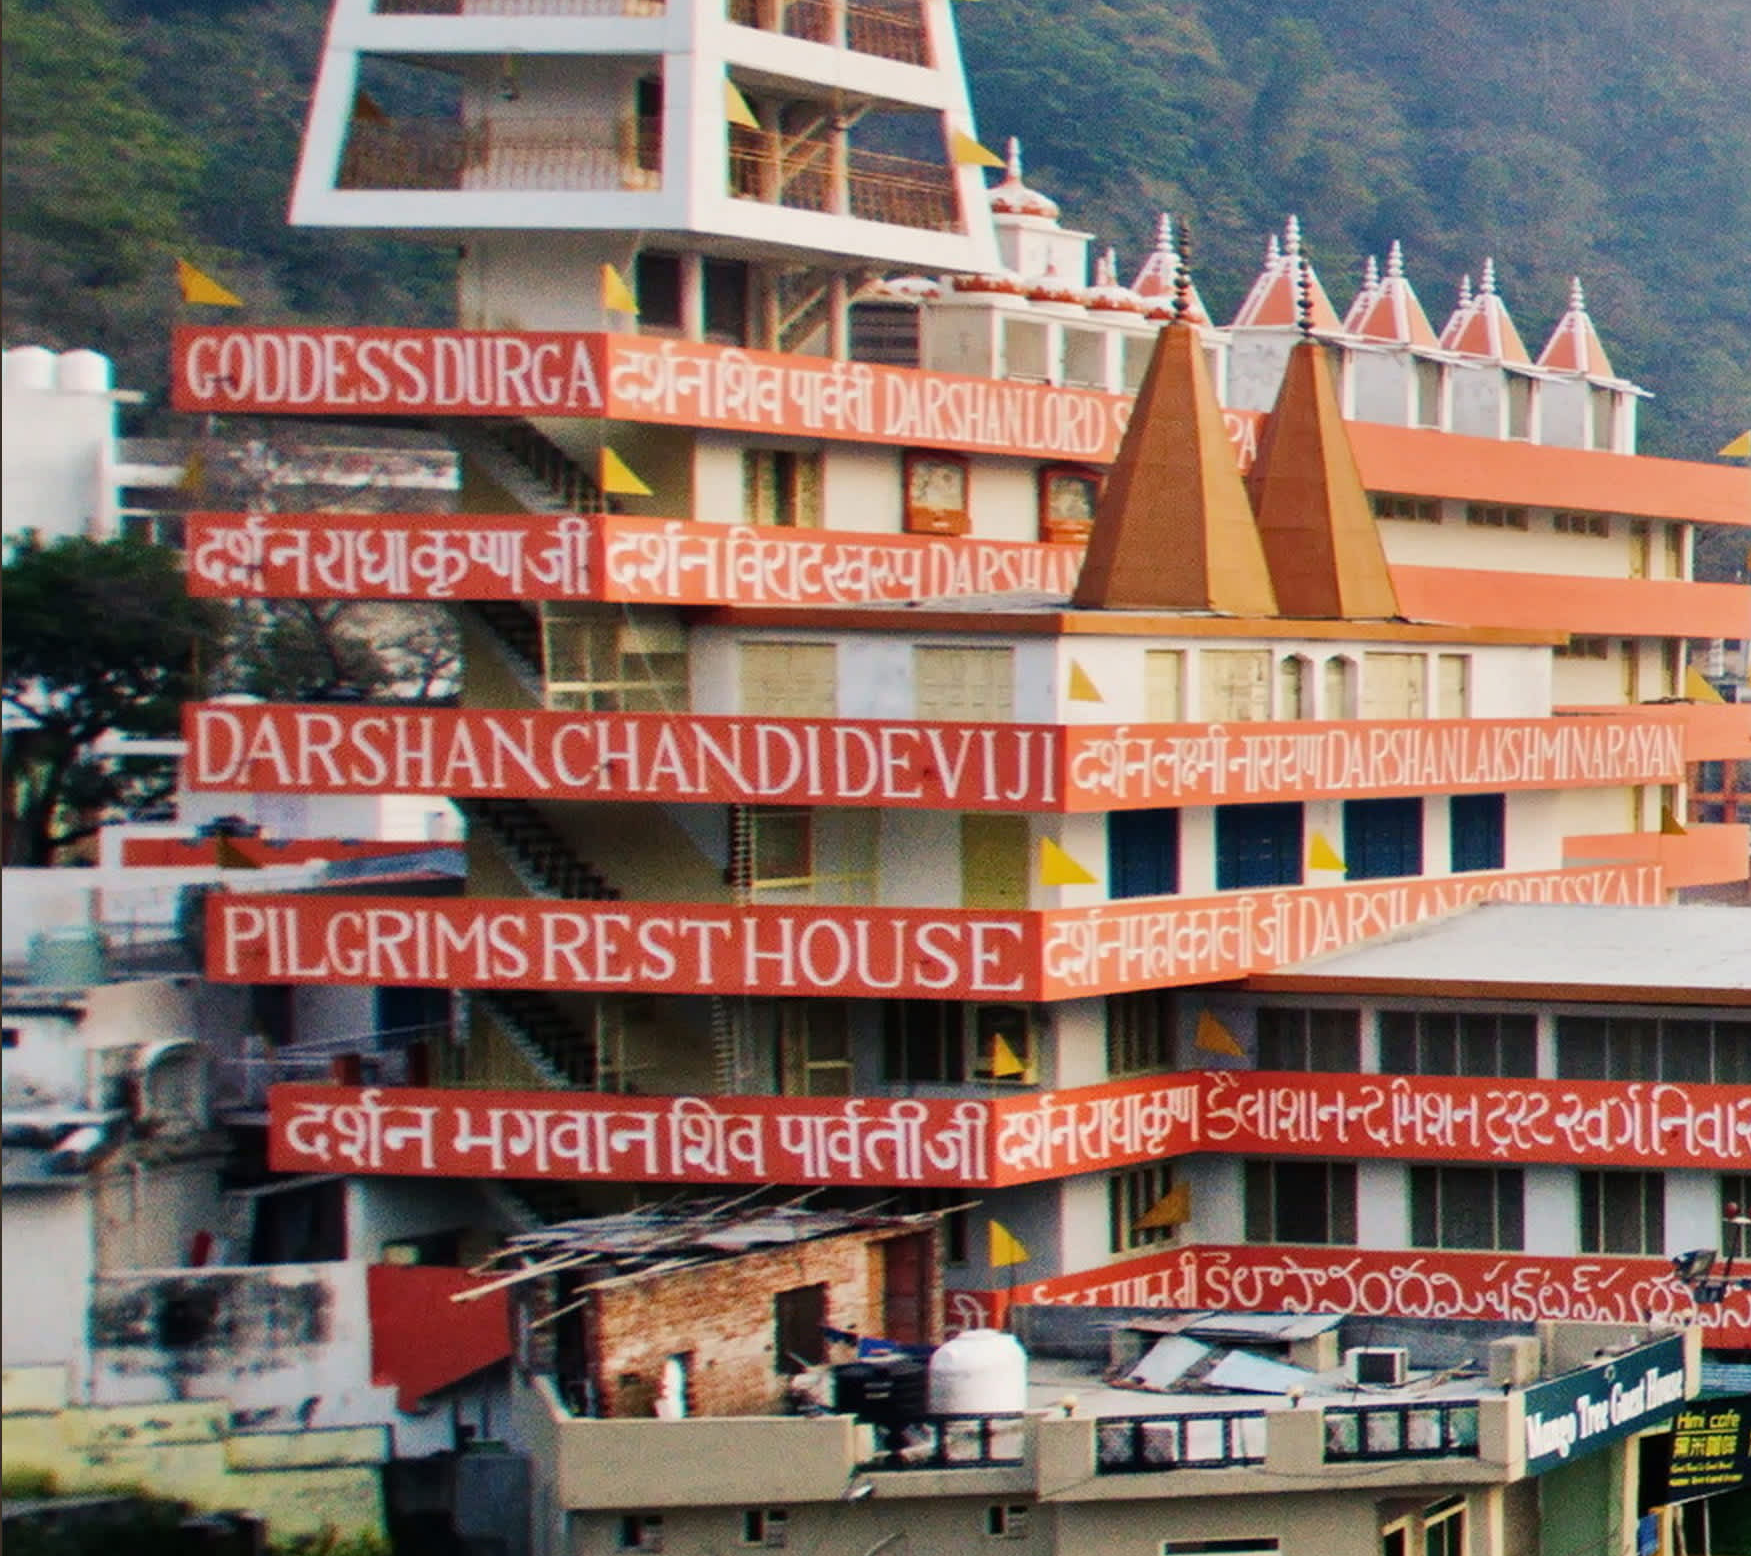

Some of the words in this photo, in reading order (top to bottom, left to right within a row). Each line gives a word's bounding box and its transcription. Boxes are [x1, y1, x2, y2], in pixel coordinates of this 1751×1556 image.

[187, 334, 428, 406] GODDESS
[433, 337, 603, 408] DURGA
[609, 341, 709, 417] दर्शन
[715, 348, 784, 424] शिव
[883, 373, 1020, 448] DARSHAN
[1024, 389, 1106, 455] LORD
[195, 516, 310, 592] दर्शन
[525, 516, 591, 595] जी
[606, 522, 720, 598] दर्शन
[725, 526, 826, 602] विराट
[197, 711, 552, 790] DARSHAN
[551, 721, 822, 796] CHANDI
[1072, 727, 1153, 797] दर्शन
[1327, 727, 1460, 790] DARSHAN
[223, 906, 530, 980] PILGRIMS
[542, 912, 731, 987] REST
[743, 917, 1025, 992] HOUSE
[1042, 909, 1127, 987] दर्शन
[285, 1089, 438, 1169] दर्शन
[453, 1108, 661, 1174] भगवान
[670, 1096, 766, 1176] शिव
[776, 1100, 926, 1180] पार्वती
[924, 1102, 989, 1181] जी
[997, 1095, 1079, 1170] दर्शन
[1392, 1078, 1480, 1147] મિશન
